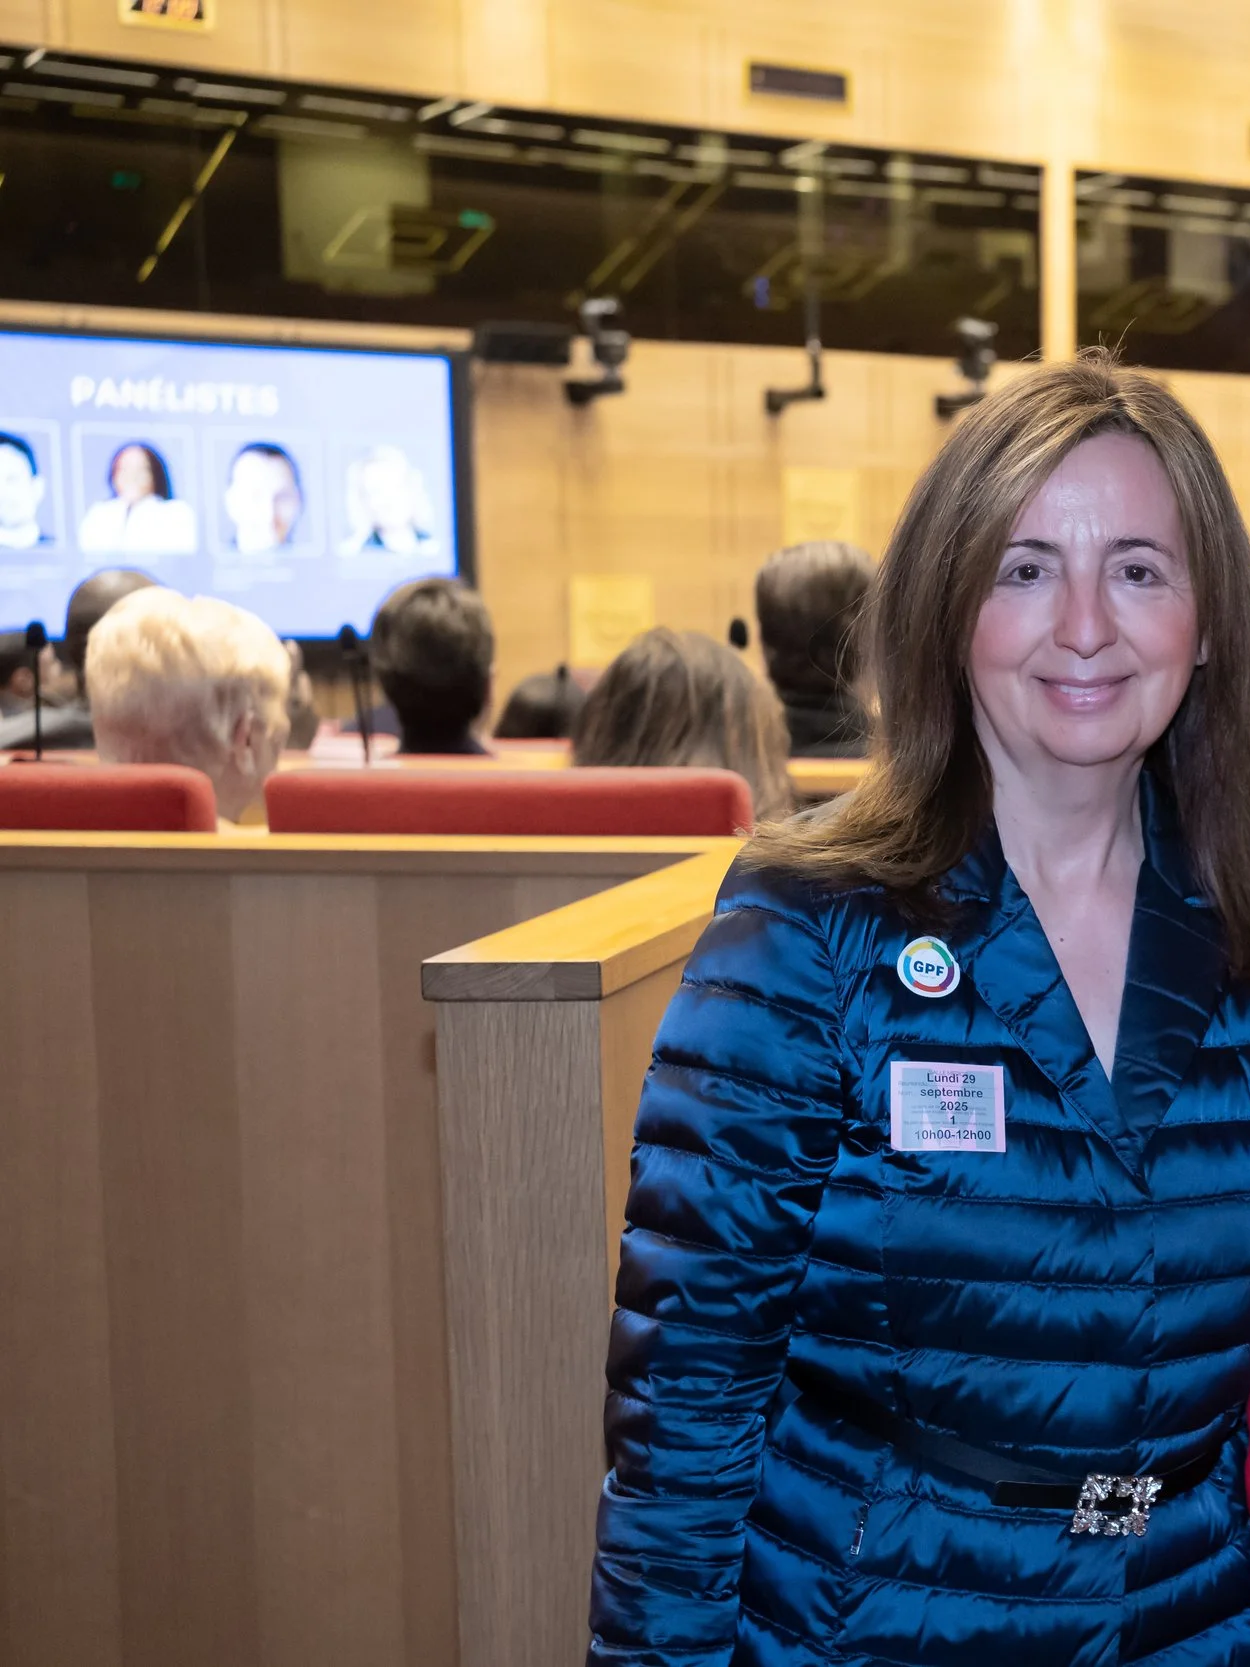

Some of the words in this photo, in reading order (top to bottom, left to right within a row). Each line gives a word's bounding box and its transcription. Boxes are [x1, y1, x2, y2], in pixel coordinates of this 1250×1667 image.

[70, 373, 279, 418] PANÉLISTES
[913, 960, 944, 977] GPF
[927, 1072, 959, 1084] Lundi
[962, 1074, 976, 1084] 29
[920, 1088, 983, 1098] septembre
[940, 1101, 968, 1111] 2025
[915, 1129, 991, 1140] 10h00-12h00
